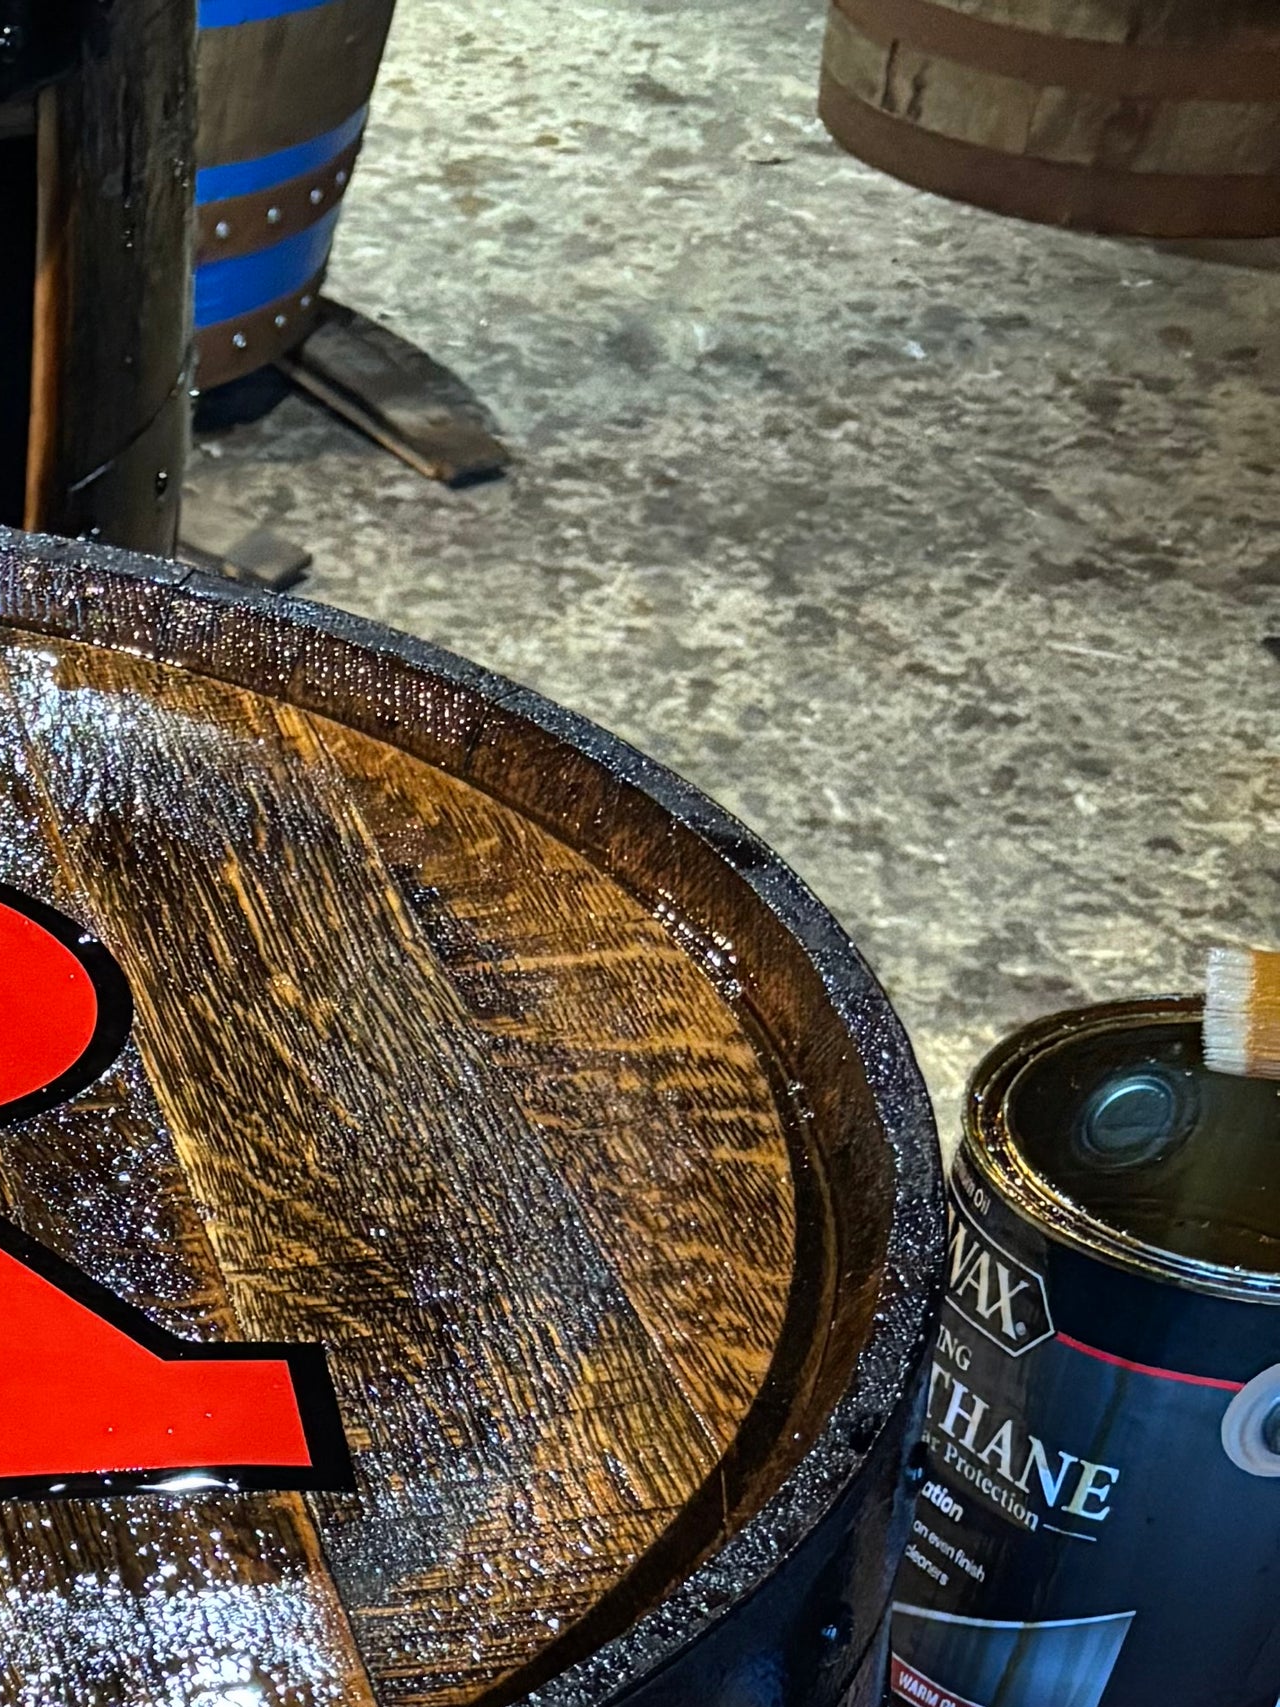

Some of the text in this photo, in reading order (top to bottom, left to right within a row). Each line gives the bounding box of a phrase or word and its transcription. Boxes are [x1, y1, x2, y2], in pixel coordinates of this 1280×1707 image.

[943, 1442, 1039, 1532] Protection
[927, 1531, 956, 1559] even
[953, 1547, 986, 1582] finish
[899, 1671, 938, 1707] WARM
